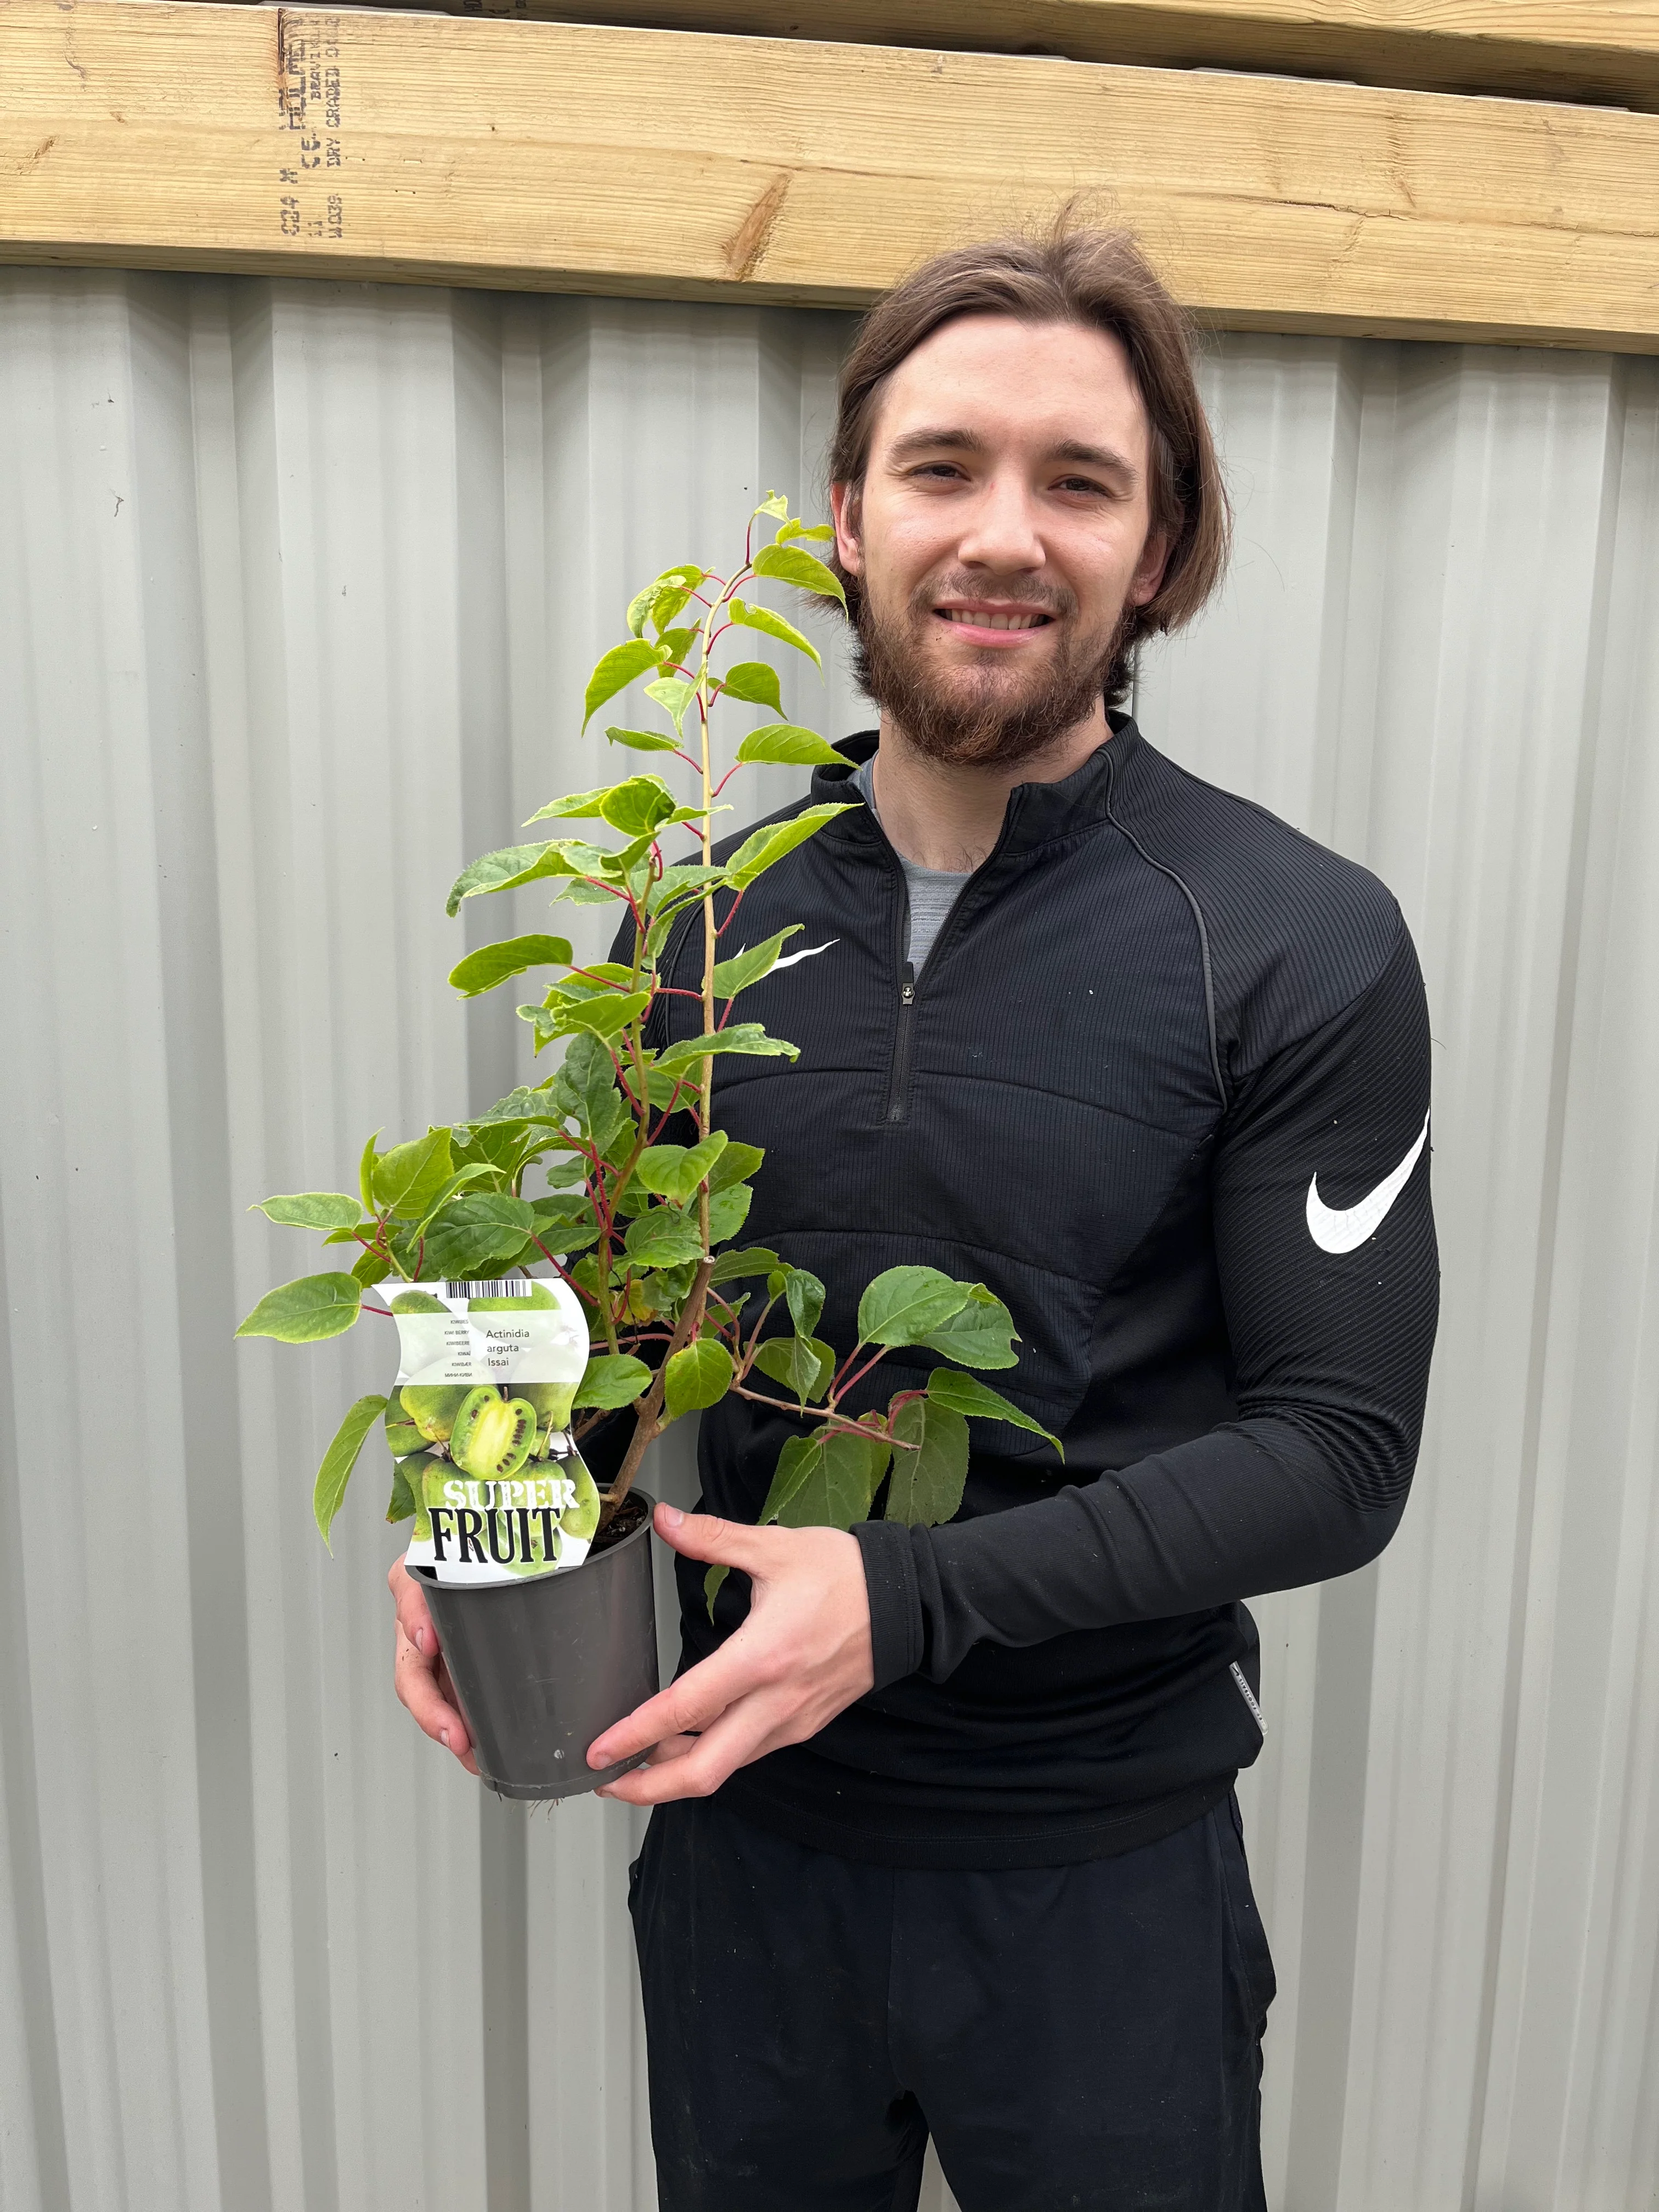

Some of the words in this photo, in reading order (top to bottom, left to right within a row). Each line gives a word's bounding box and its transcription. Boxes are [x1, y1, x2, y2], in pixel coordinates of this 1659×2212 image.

[486, 1329, 530, 1338] Actinidia
[487, 1344, 519, 1355] arguta
[488, 1357, 509, 1366] Issai
[443, 1479, 580, 1512] SUPER
[428, 1507, 561, 1564] FRUIT
